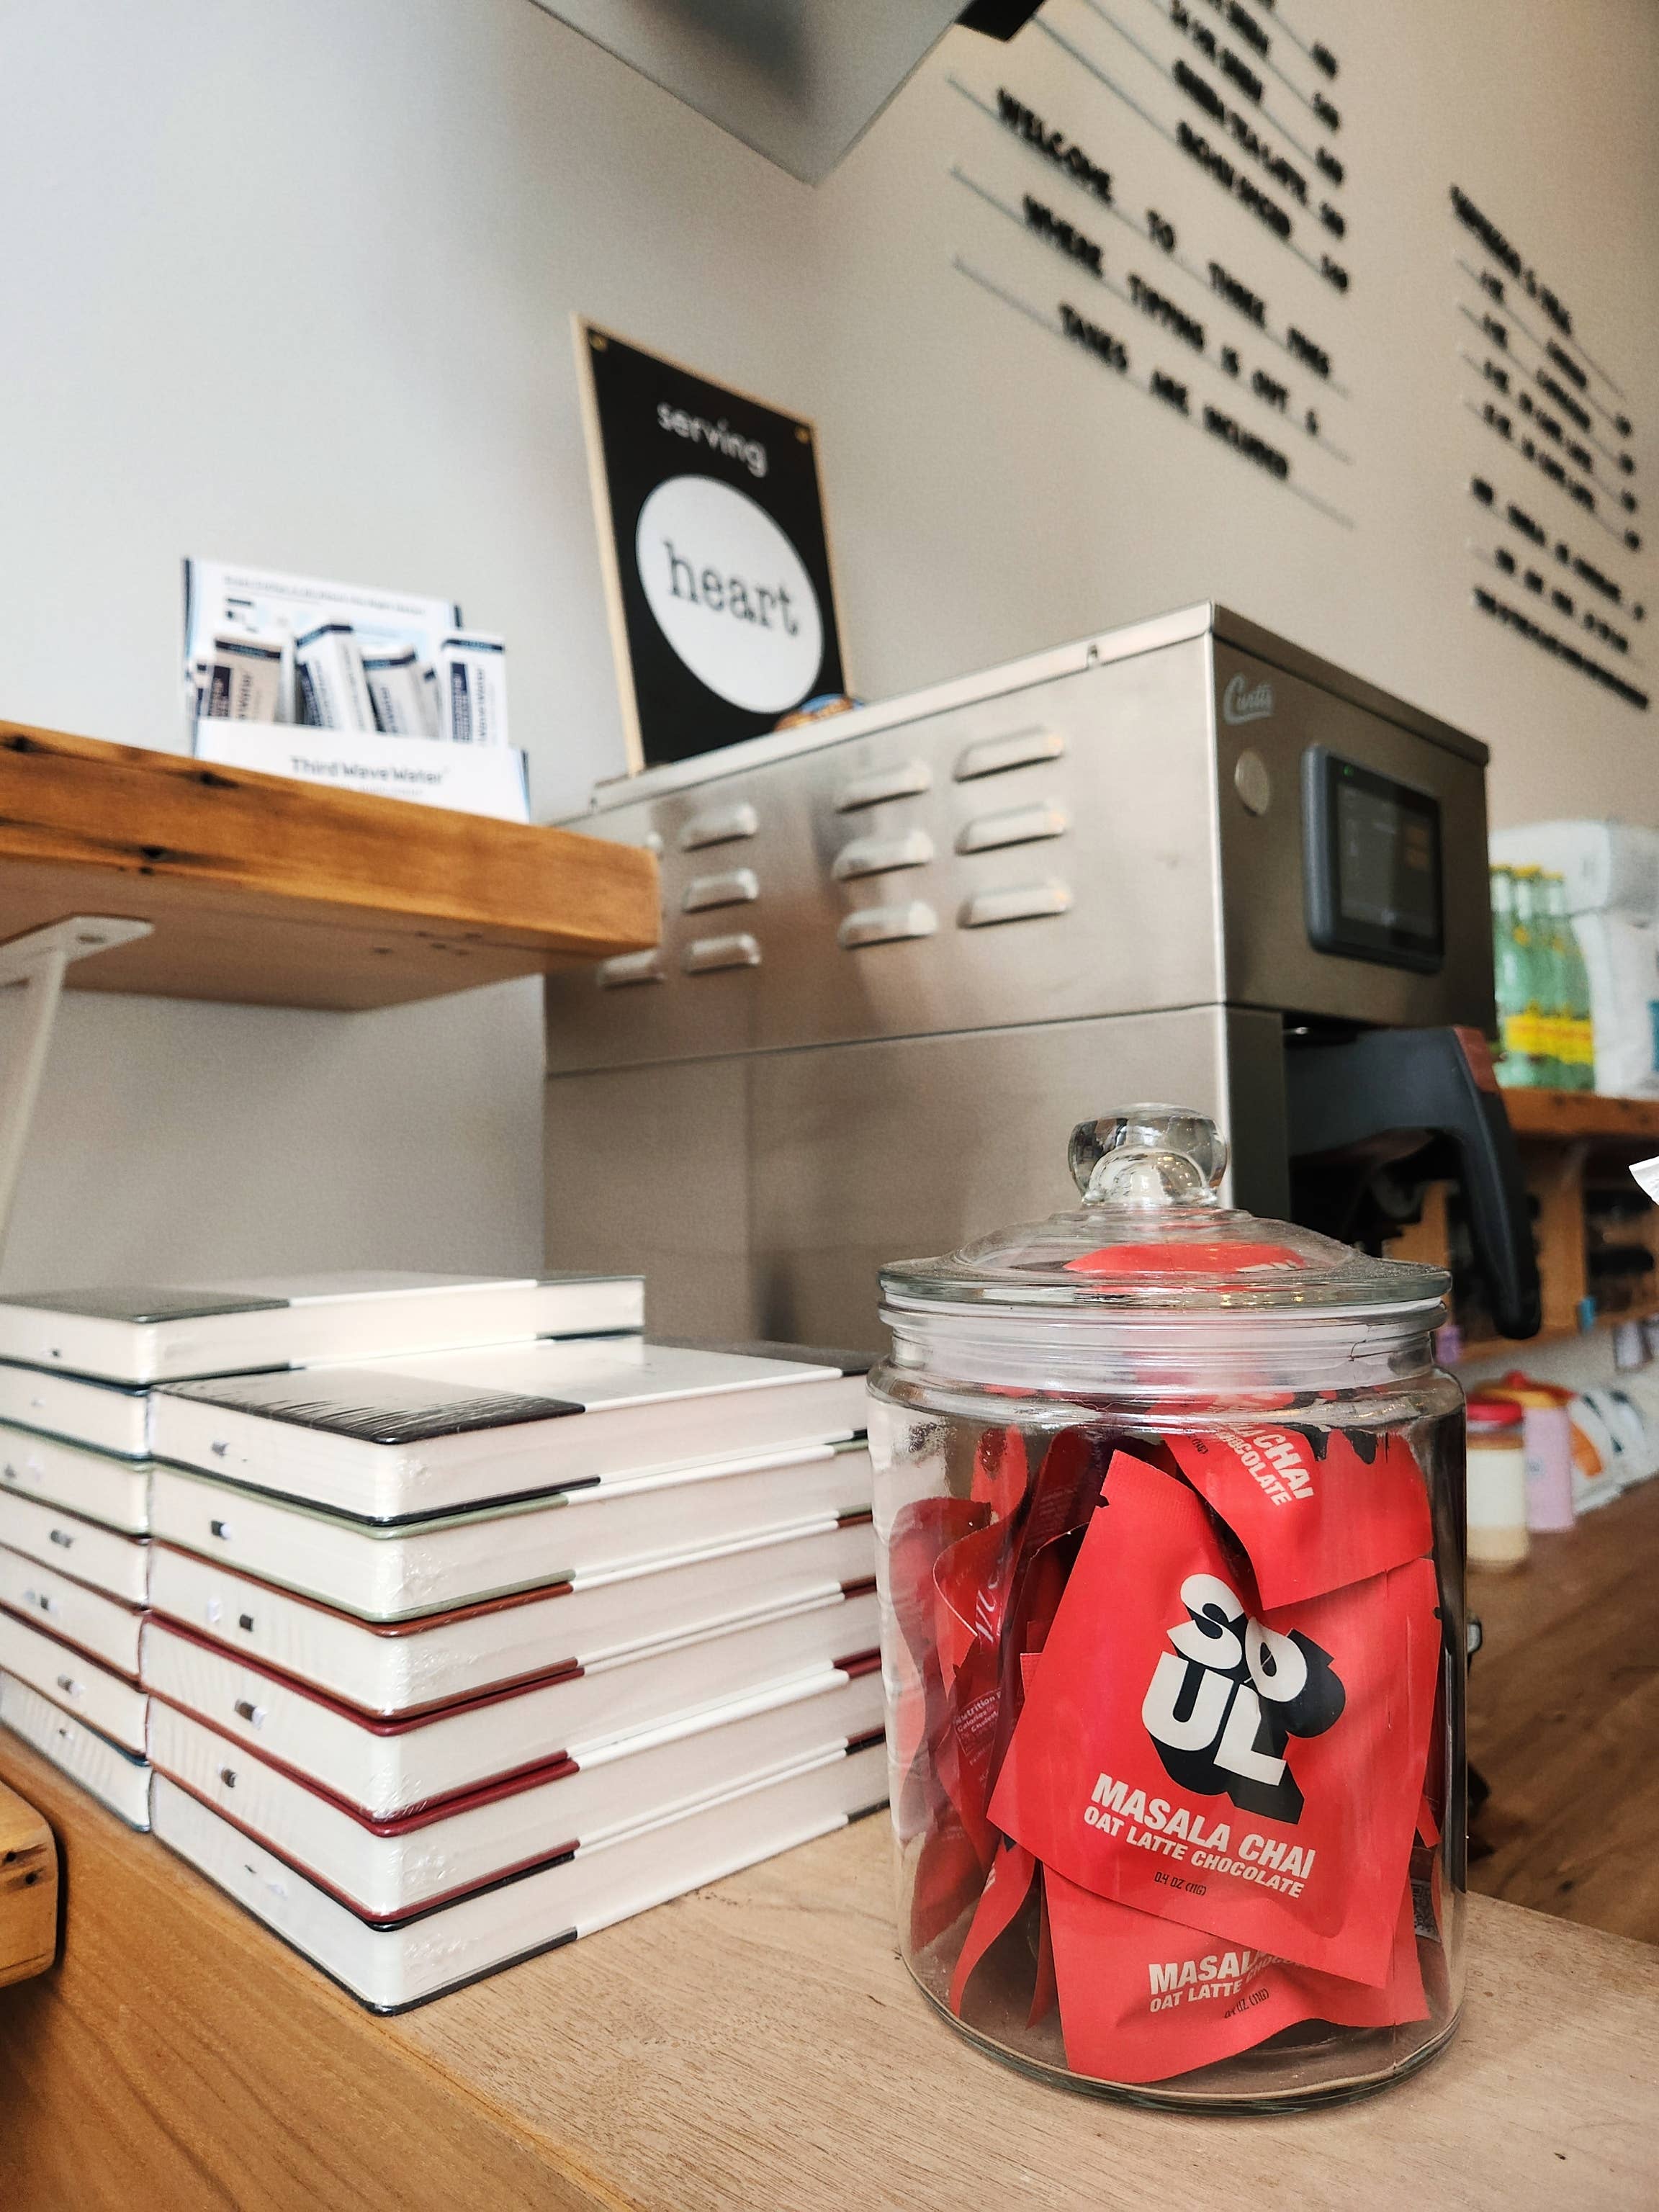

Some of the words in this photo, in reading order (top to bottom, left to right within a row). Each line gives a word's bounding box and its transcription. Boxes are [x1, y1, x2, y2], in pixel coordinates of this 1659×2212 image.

[997, 87, 1113, 205] WELCOME
[1147, 209, 1175, 253] TO
[656, 402, 768, 478] serving
[662, 539, 800, 637] heart
[291, 755, 338, 778] Third
[342, 761, 390, 781] Wave
[393, 768, 442, 786] Water
[1253, 1434, 1314, 1500] CHAI
[1141, 1573, 1309, 1787] SOUL
[1083, 1806, 1124, 1837] OAT
[1125, 1826, 1189, 1861] LATTE
[1190, 1850, 1305, 1899] CHOCOLATE
[1090, 1773, 1231, 1853] MASALA
[1238, 1833, 1316, 1879] CHAI
[1171, 1878, 1184, 1890] OZ
[1150, 1991, 1184, 2013] OAT
[1188, 1979, 1244, 2002] LATTE
